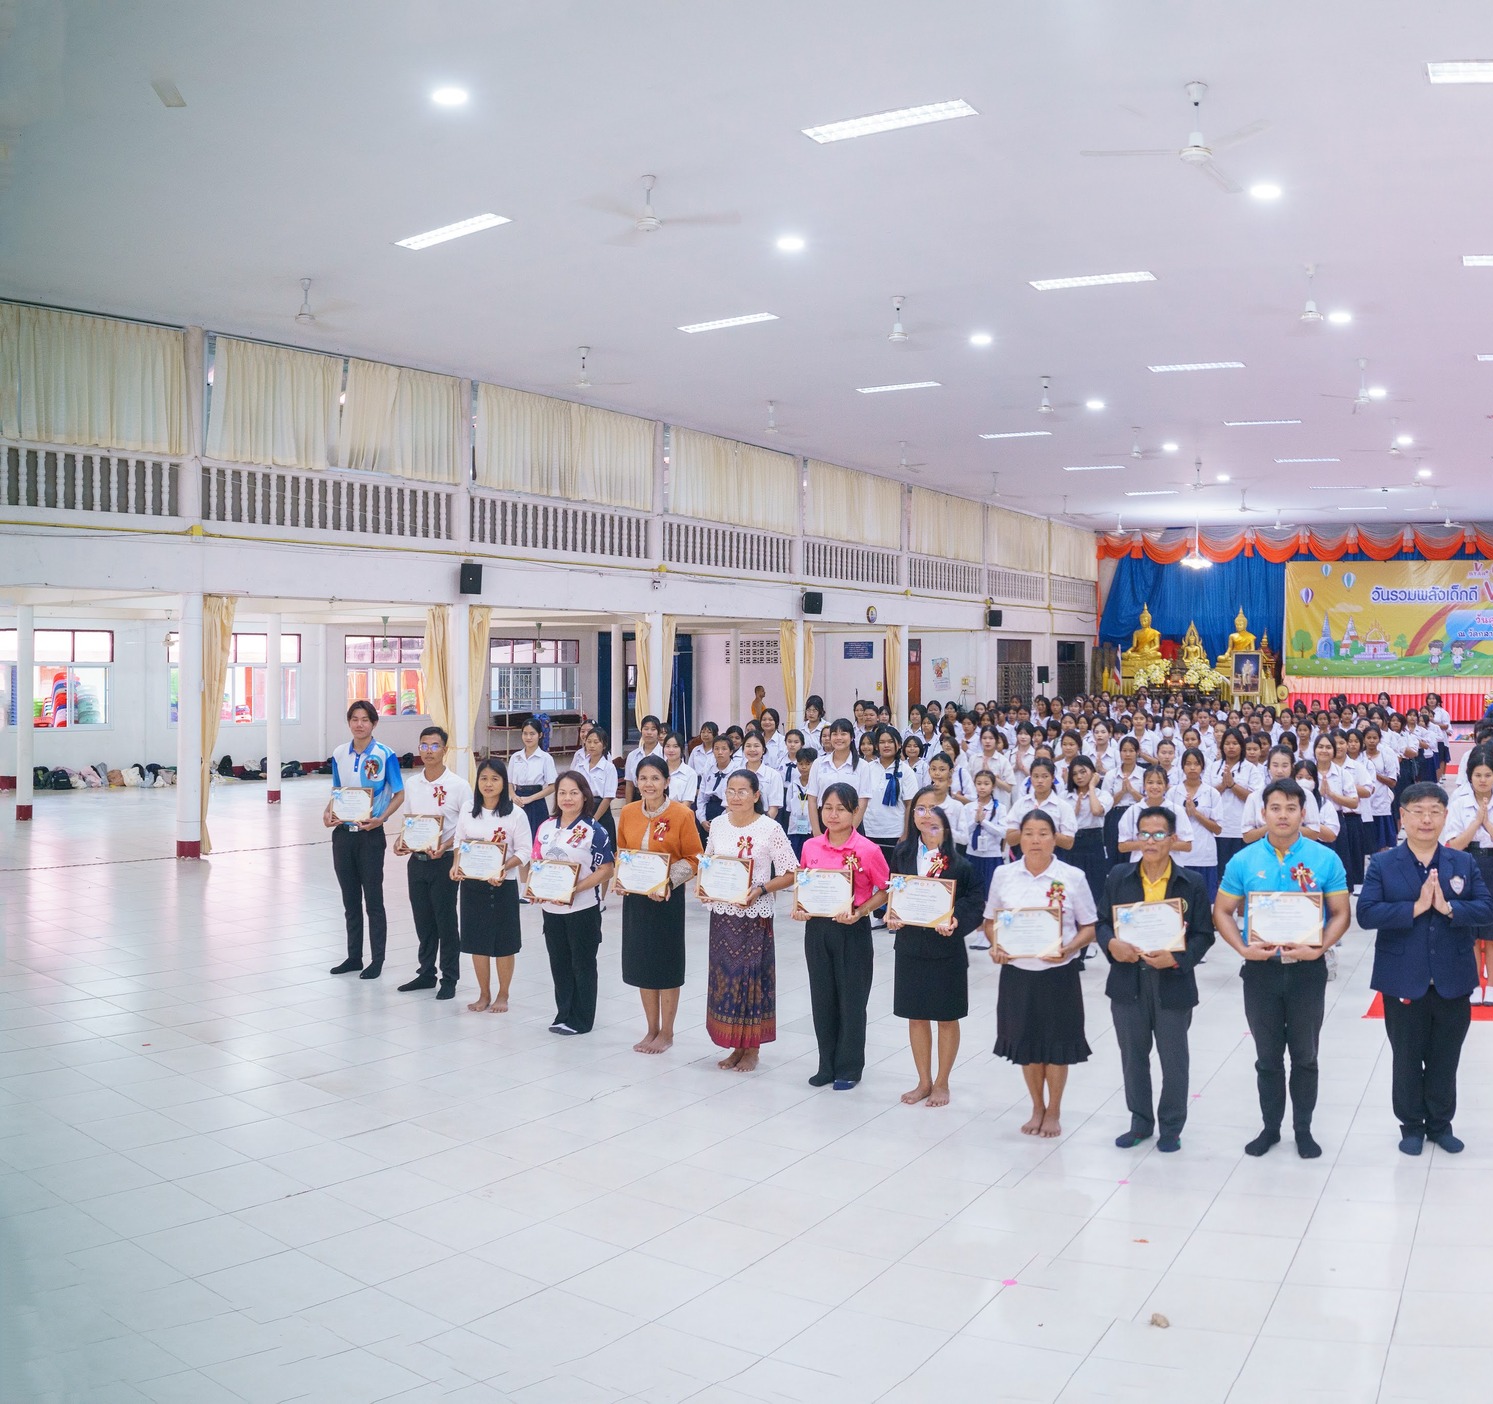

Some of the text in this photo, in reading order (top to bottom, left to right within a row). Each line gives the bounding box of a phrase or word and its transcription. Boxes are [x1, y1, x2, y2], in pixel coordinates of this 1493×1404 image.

[1371, 585, 1478, 601] วันรวมพลังเด็กดี
